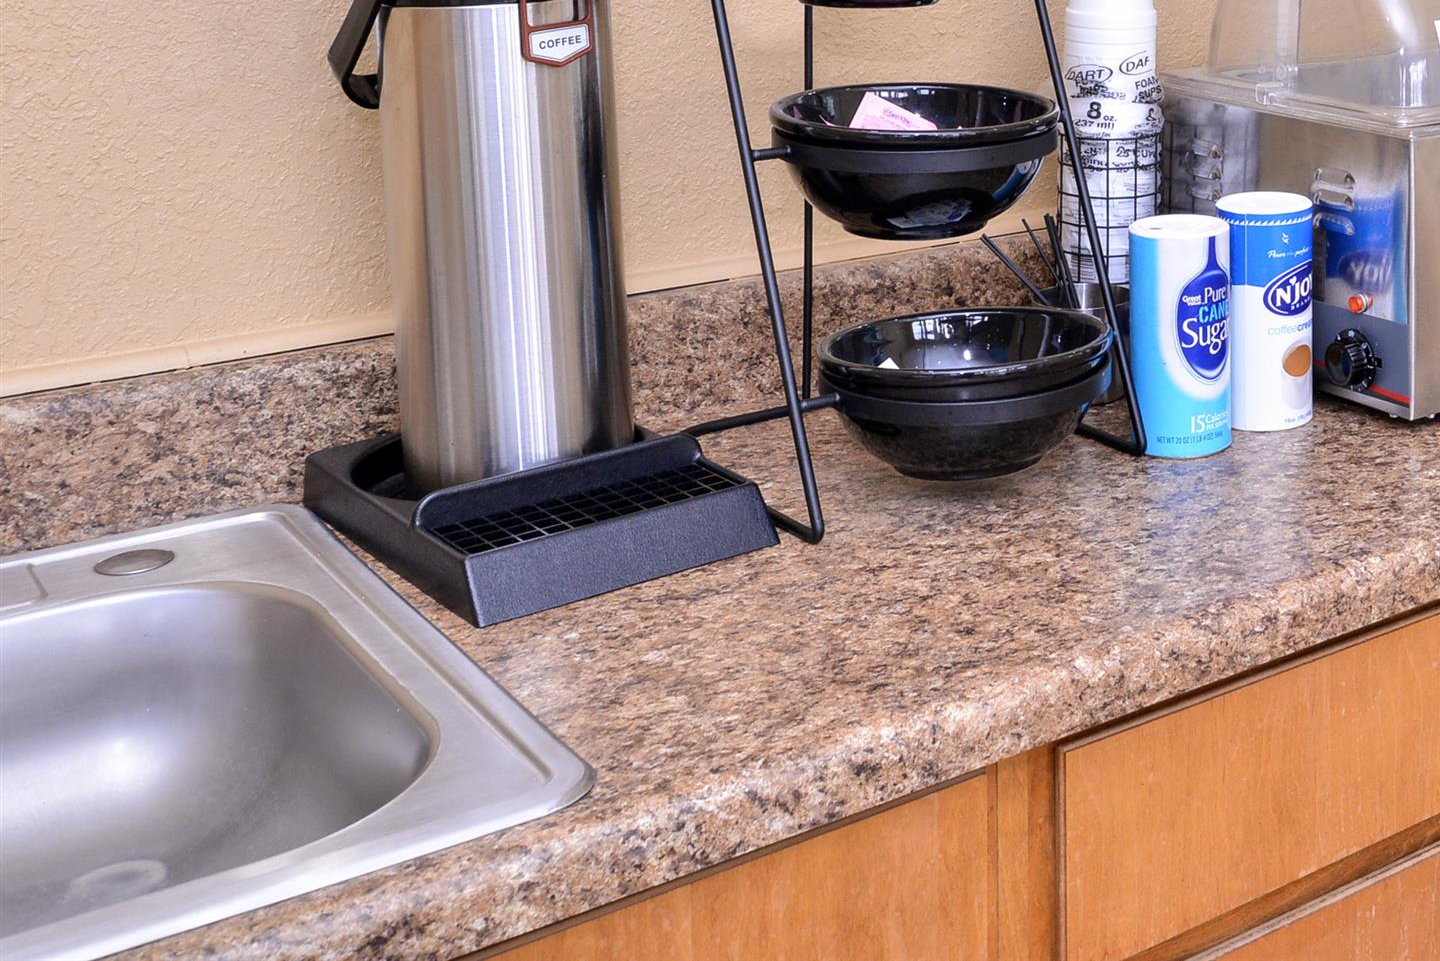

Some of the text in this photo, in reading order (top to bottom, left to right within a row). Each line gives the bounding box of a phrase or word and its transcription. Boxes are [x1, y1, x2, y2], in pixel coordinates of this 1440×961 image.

[539, 34, 582, 50] COFFEE
[1067, 69, 1105, 81] DART
[1086, 101, 1102, 120] 8
[1204, 286, 1226, 303] Pure
[1191, 414, 1205, 433] 15
